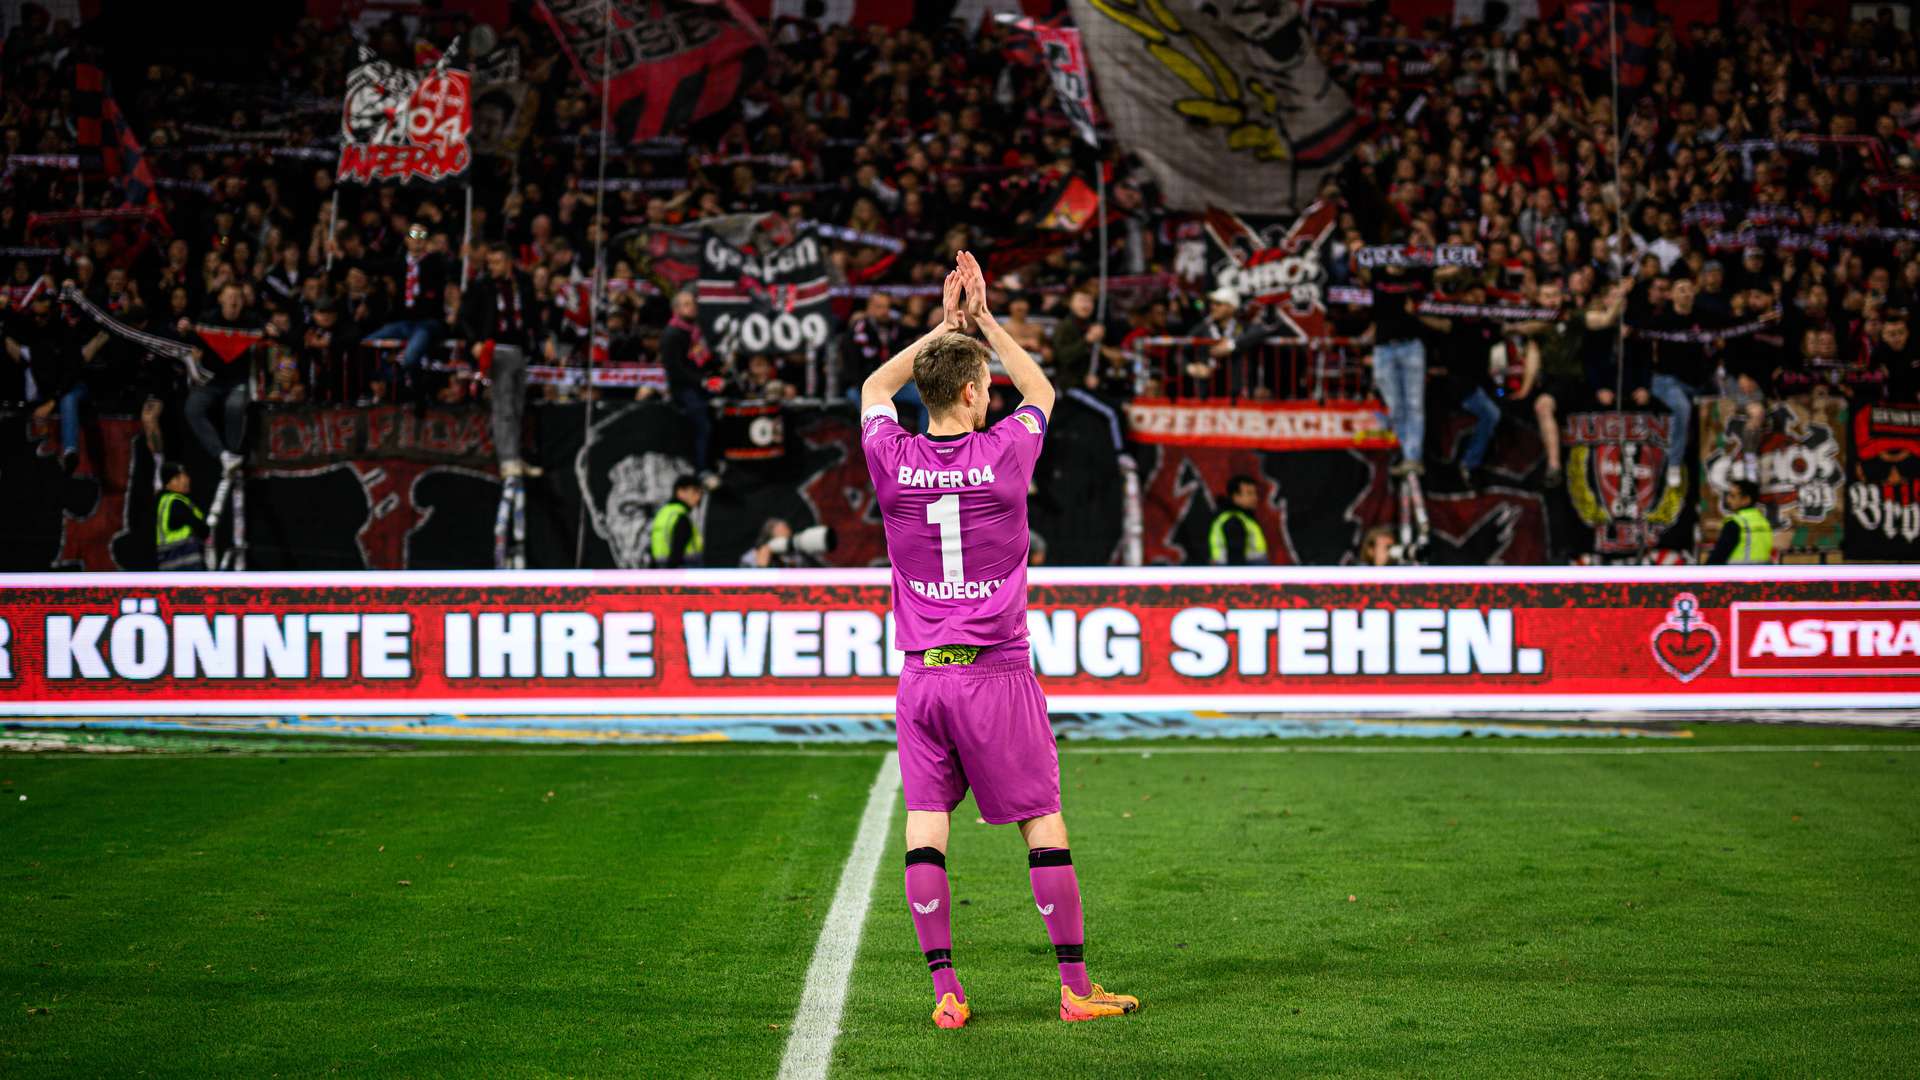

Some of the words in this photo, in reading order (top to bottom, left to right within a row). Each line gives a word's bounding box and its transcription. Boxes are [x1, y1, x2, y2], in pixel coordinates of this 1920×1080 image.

[337, 141, 472, 185] INFERNO
[714, 313, 828, 352] 2009
[269, 406, 497, 462] DIFFIDA
[1561, 412, 1672, 448] JUGEN
[897, 465, 965, 488] BAYER
[968, 464, 996, 487] 04
[925, 494, 965, 584] 1
[908, 580, 1007, 600] RADECKY
[45, 597, 411, 680] KÖNNTE
[445, 611, 656, 679] IHRE
[683, 607, 1142, 679] WERNG
[1170, 606, 1545, 676] STEHEN.
